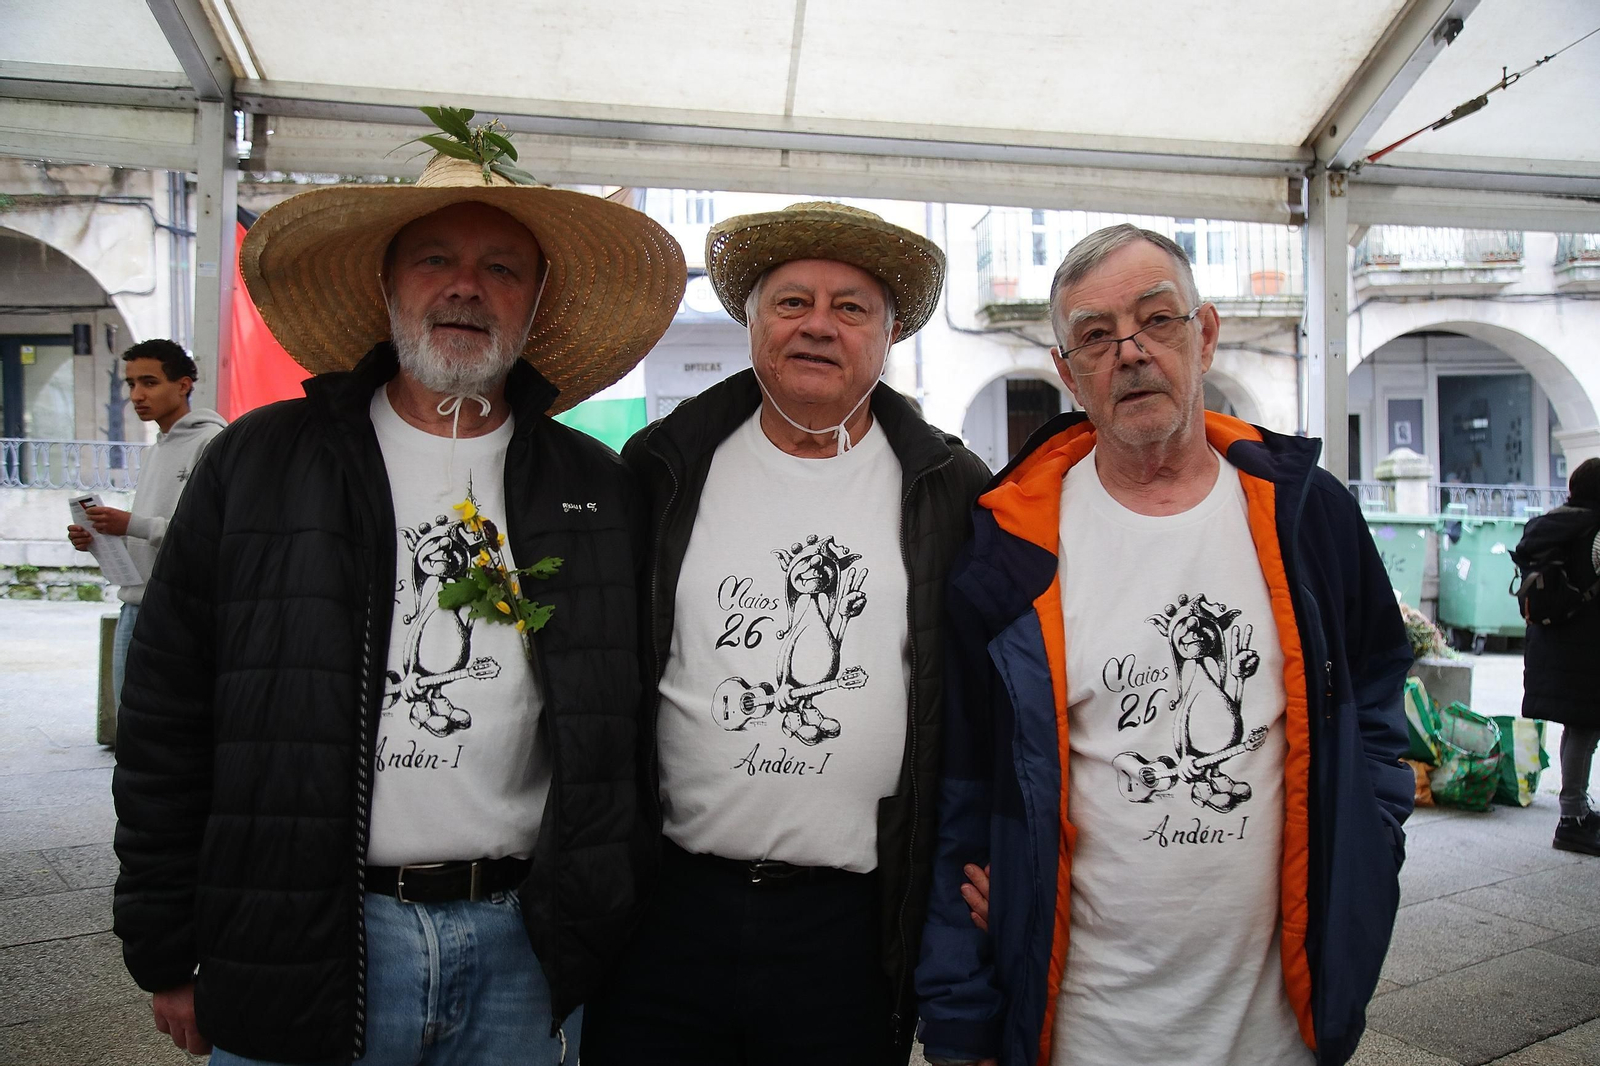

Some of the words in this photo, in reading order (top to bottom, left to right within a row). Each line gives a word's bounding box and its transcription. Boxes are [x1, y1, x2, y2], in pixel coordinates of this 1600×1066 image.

[684, 363, 722, 372] OPTICAS
[718, 575, 779, 611] Maios
[715, 613, 774, 649] 26
[1103, 654, 1169, 692] Maios
[1118, 688, 1168, 731] 26
[733, 743, 833, 776] Andén-I
[1142, 815, 1249, 847] Andén-I
